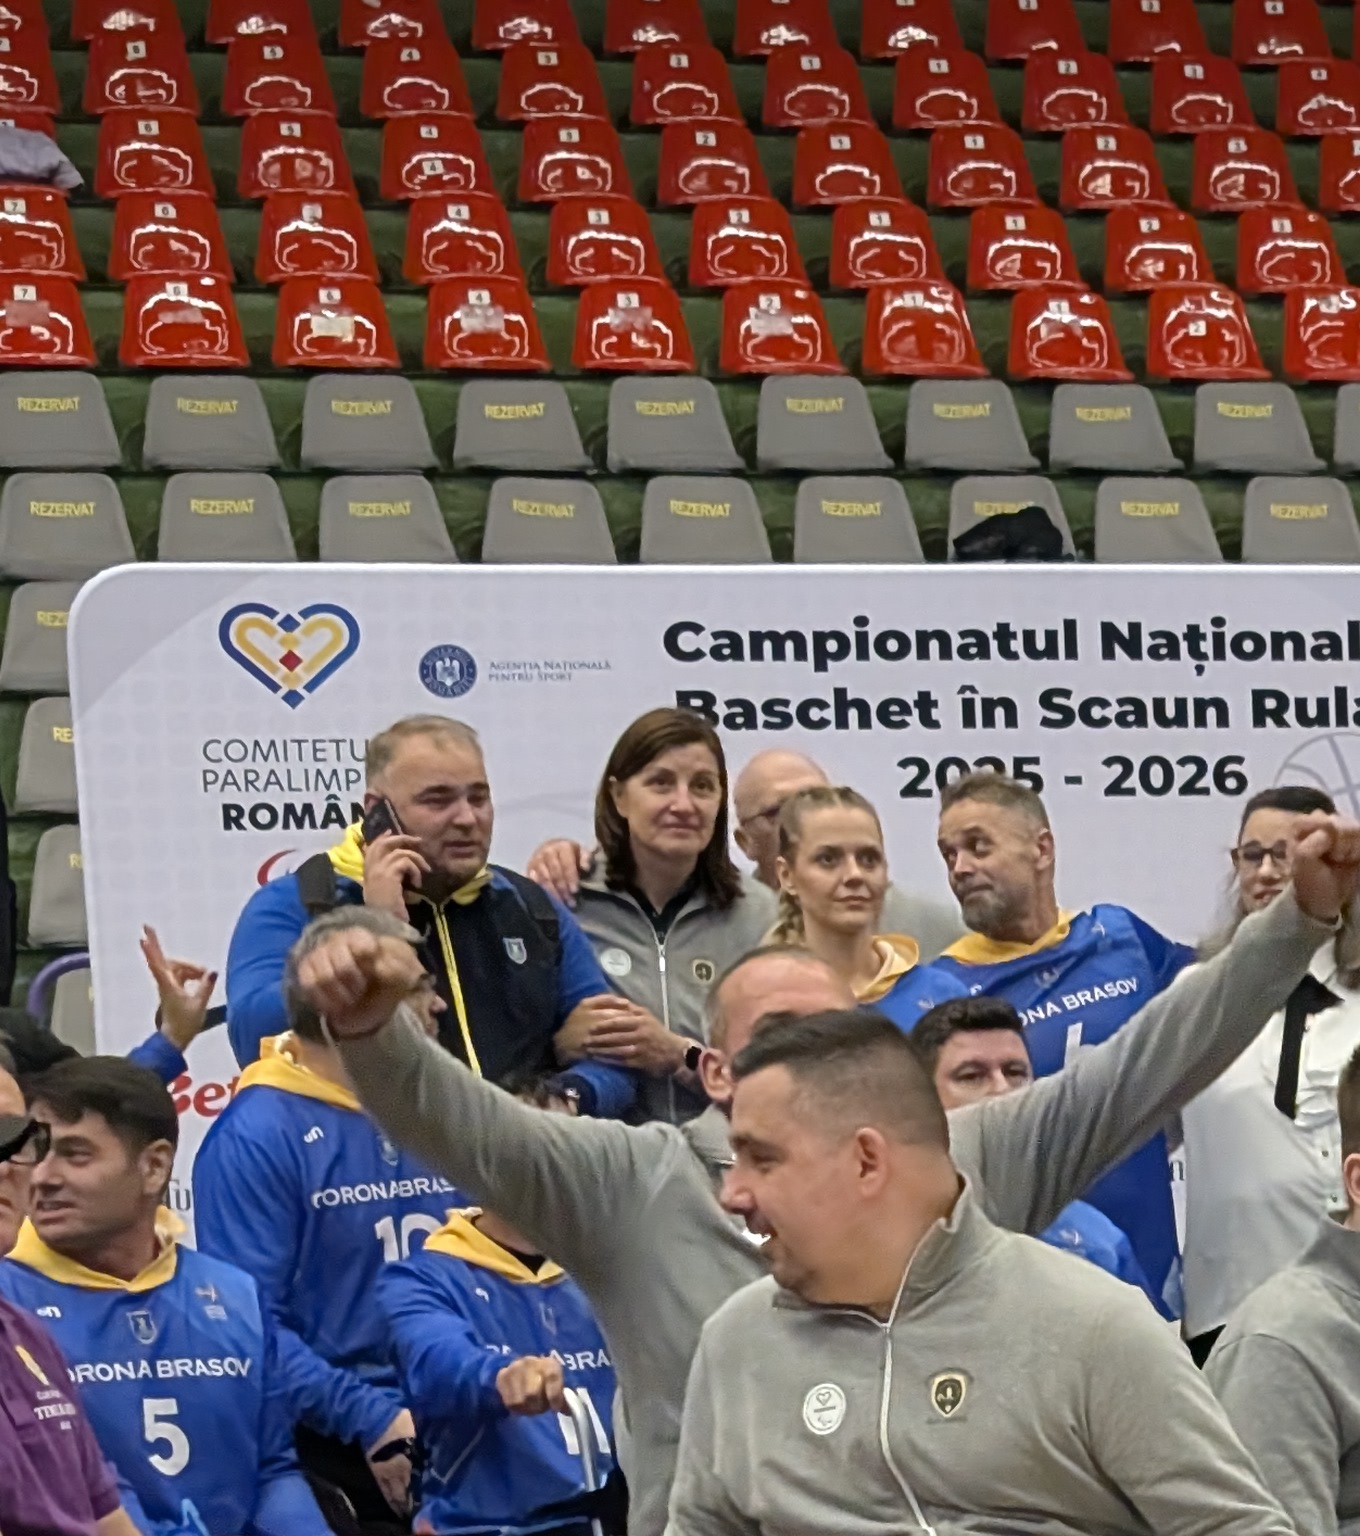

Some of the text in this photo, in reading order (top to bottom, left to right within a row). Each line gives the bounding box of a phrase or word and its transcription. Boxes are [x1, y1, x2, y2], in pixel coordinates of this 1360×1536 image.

[18, 397, 80, 413] REZERVAT
[177, 398, 238, 416] REZERVAT
[331, 400, 391, 416] REZERVAT
[484, 402, 545, 420] REZERVAT
[636, 400, 694, 416] REZERVAT
[785, 397, 843, 414] REZERVAT
[29, 500, 95, 517] REZERVAT
[190, 498, 254, 515] REZERVAT
[348, 501, 411, 517] REZERVAT
[512, 498, 575, 519] REZERVAT
[668, 499, 731, 518] REZERVAT
[821, 500, 881, 517] REZERVAT
[663, 615, 1078, 672] Campionatul
[676, 687, 941, 731] Baschet
[957, 684, 1019, 730] în
[1038, 687, 1230, 730] Scaun
[202, 738, 369, 763] COMITETU
[202, 768, 362, 793] PARALIMP
[1101, 754, 1249, 798] 2026
[1061, 976, 1139, 1011] BRASOV
[156, 1356, 252, 1379] BRASOV
[142, 1397, 191, 1476] 5
